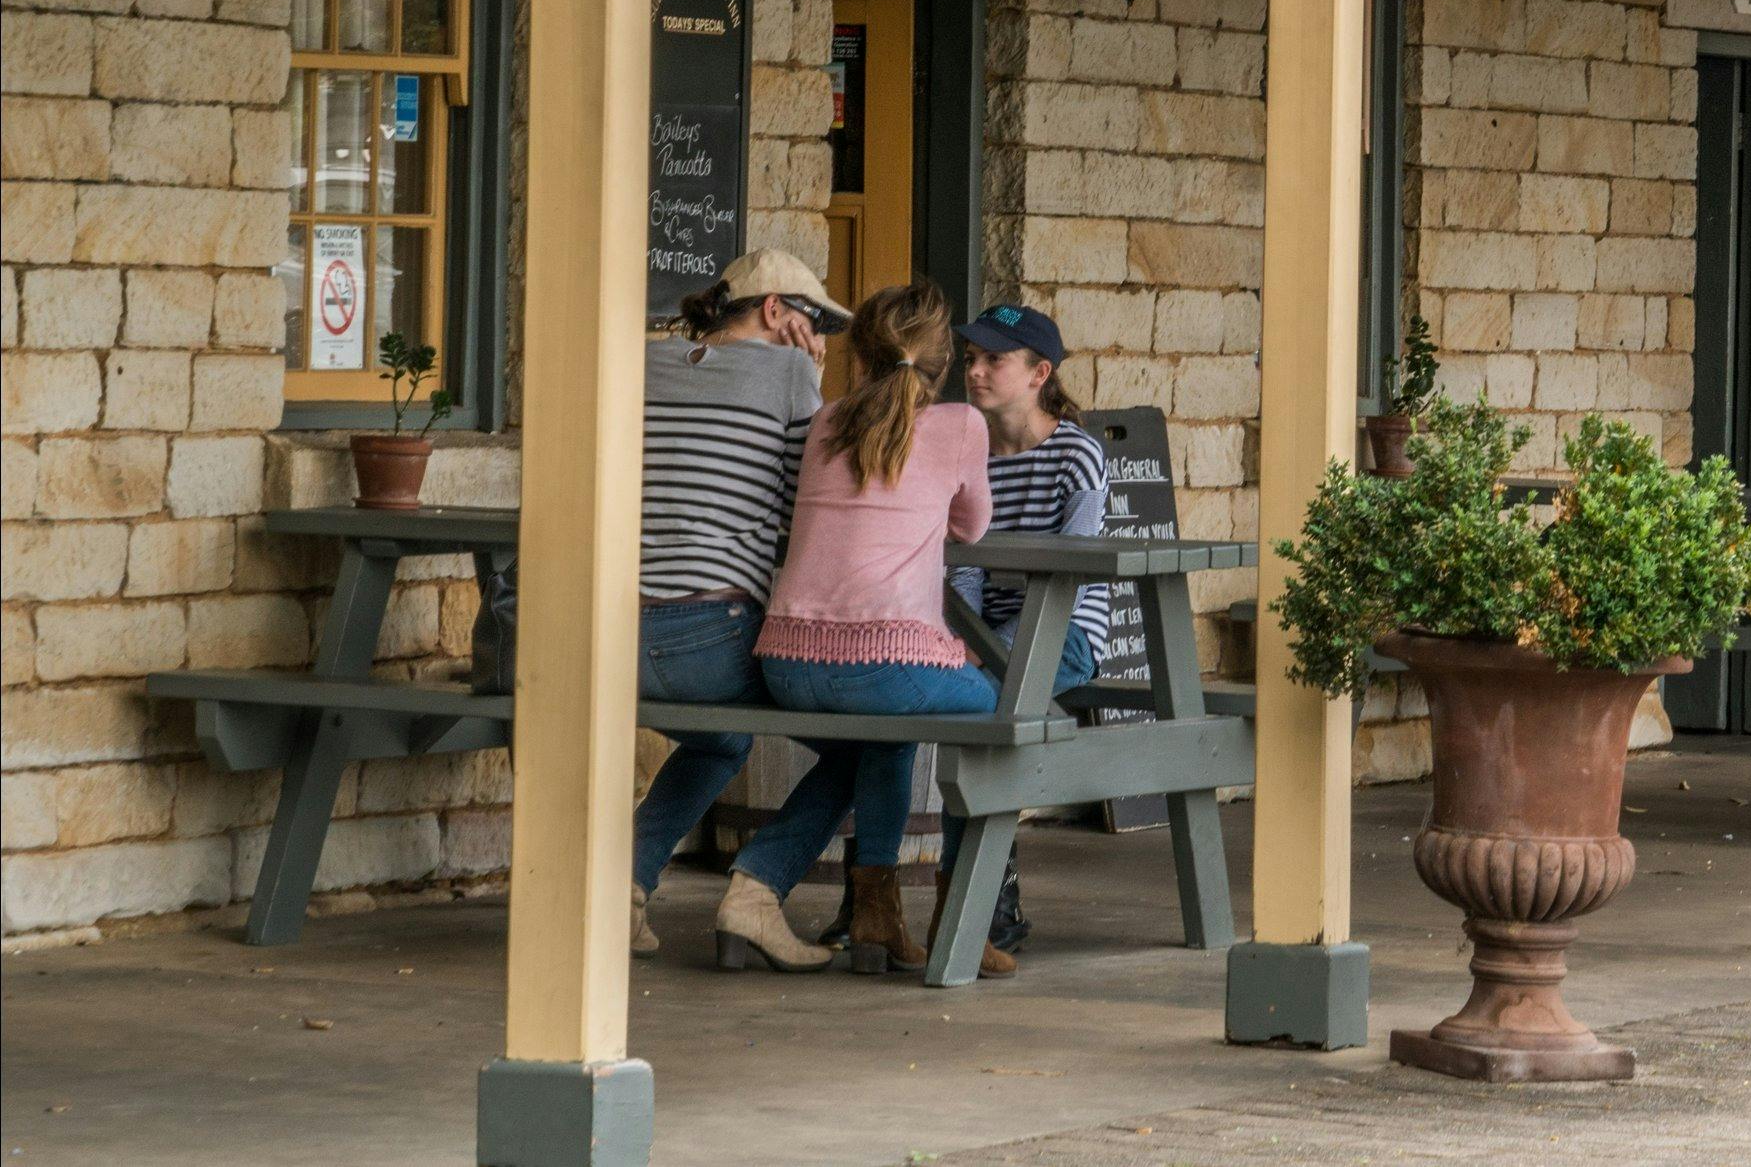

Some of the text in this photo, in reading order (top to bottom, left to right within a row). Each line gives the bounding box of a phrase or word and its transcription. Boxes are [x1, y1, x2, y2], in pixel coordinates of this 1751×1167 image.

[694, 17, 726, 32] SPECIAL
[651, 113, 702, 154] Baileys
[1121, 456, 1165, 481] GENERAL
[1110, 491, 1130, 516] INN
